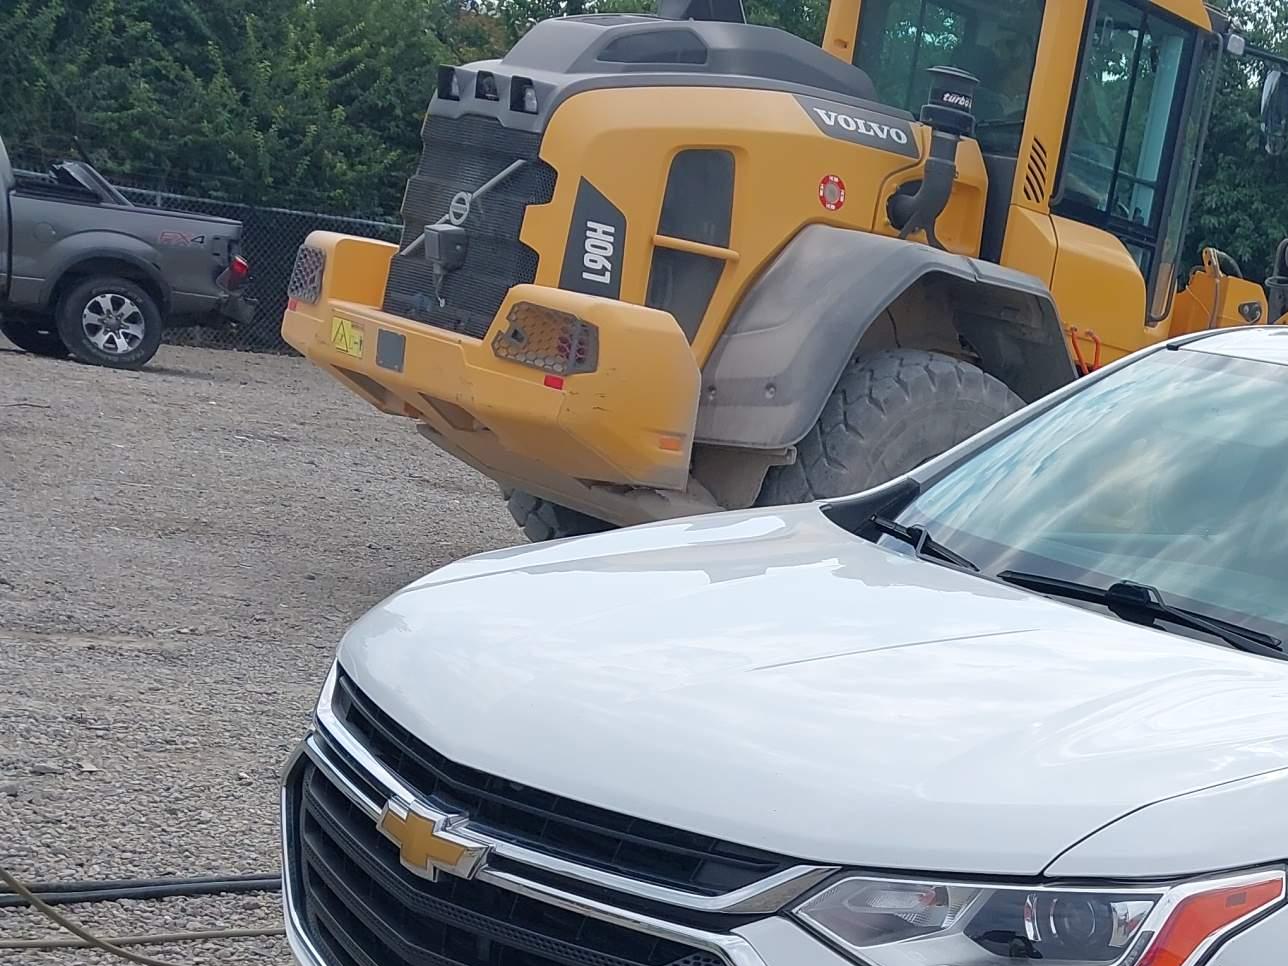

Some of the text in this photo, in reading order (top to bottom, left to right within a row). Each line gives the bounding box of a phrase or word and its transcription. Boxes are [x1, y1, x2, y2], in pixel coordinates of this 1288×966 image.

[813, 107, 908, 144] VOLVO
[160, 231, 206, 247] FX4
[582, 221, 615, 284] L90H
